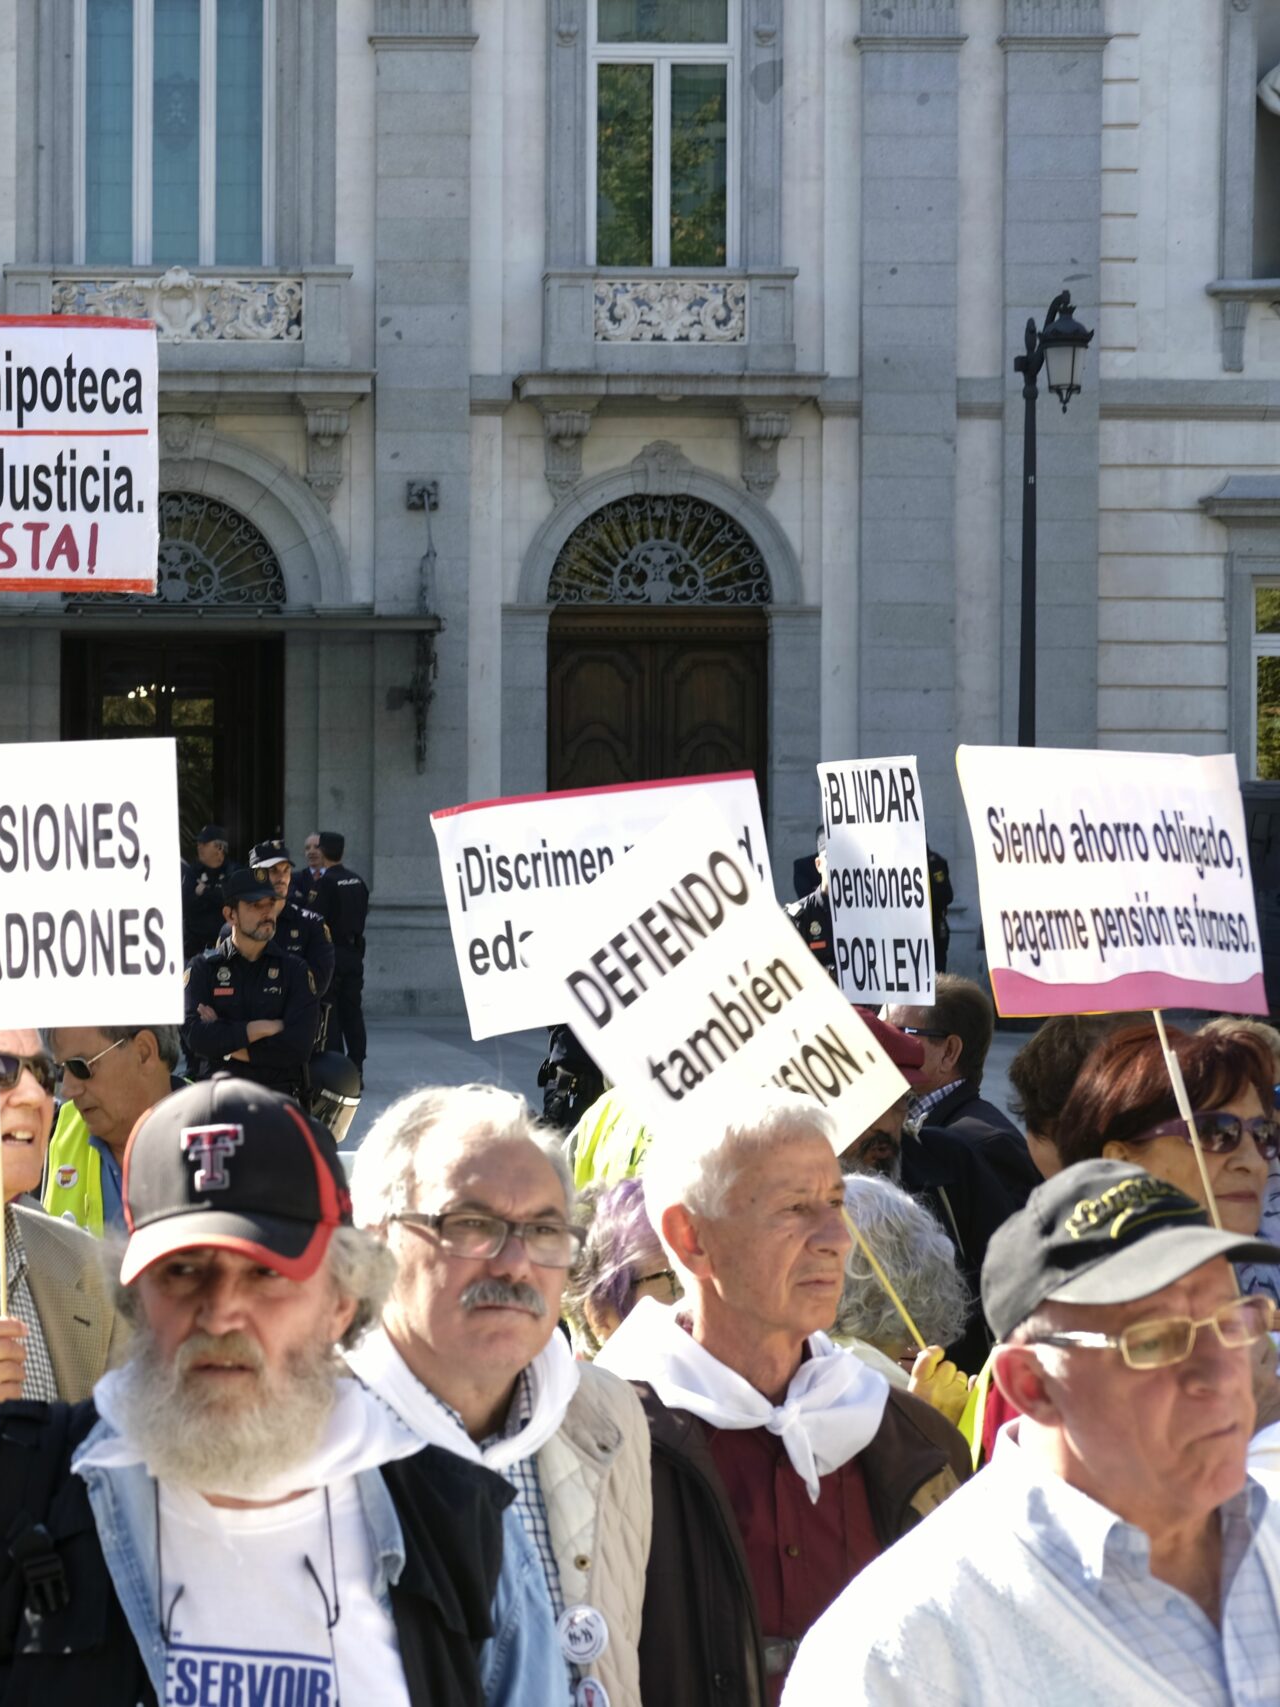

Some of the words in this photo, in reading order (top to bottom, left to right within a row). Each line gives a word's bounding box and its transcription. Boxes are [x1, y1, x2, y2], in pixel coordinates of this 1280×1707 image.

[824, 768, 919, 838] ¡BLINDAR
[987, 806, 1065, 864] Siendo
[1070, 808, 1149, 863] ahorro
[1153, 810, 1244, 880] obligado,
[830, 855, 925, 921] pensiones
[469, 920, 534, 976] ed
[565, 850, 750, 1029] DEFIENDO
[836, 937, 880, 991] POR
[882, 938, 930, 992] LEY!
[1000, 907, 1088, 967] pagarme
[1091, 891, 1174, 962] pensión
[1174, 905, 1196, 947] es
[647, 956, 805, 1101] también
